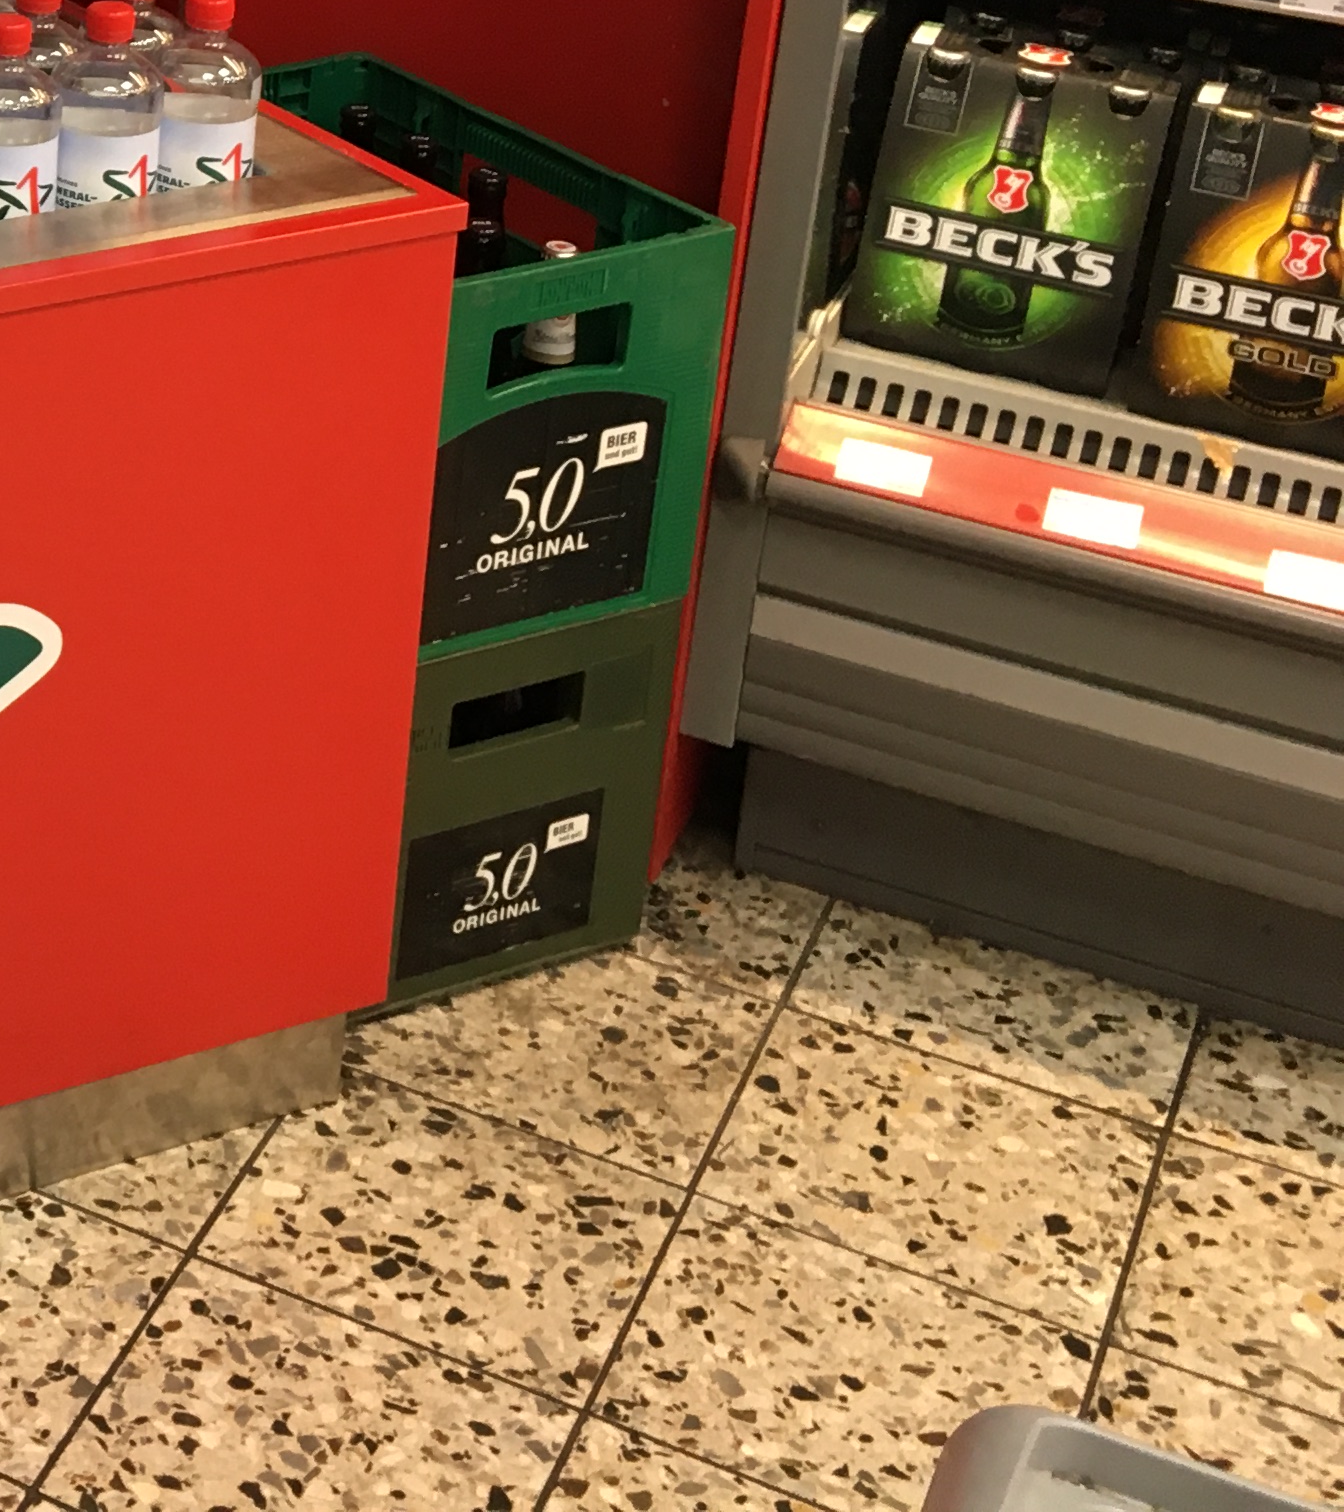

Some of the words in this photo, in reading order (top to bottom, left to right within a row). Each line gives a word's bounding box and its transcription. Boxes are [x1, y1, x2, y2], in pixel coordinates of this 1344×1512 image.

[885, 205, 1115, 288] BECK'S
[1172, 273, 1344, 343] BECK
[1227, 340, 1338, 380] GOLD
[606, 430, 637, 449] BIER
[490, 457, 585, 544] 5,0
[476, 531, 589, 574] ORIGINAL
[463, 843, 538, 913] 5,0
[452, 897, 541, 934] ORIGINAL
